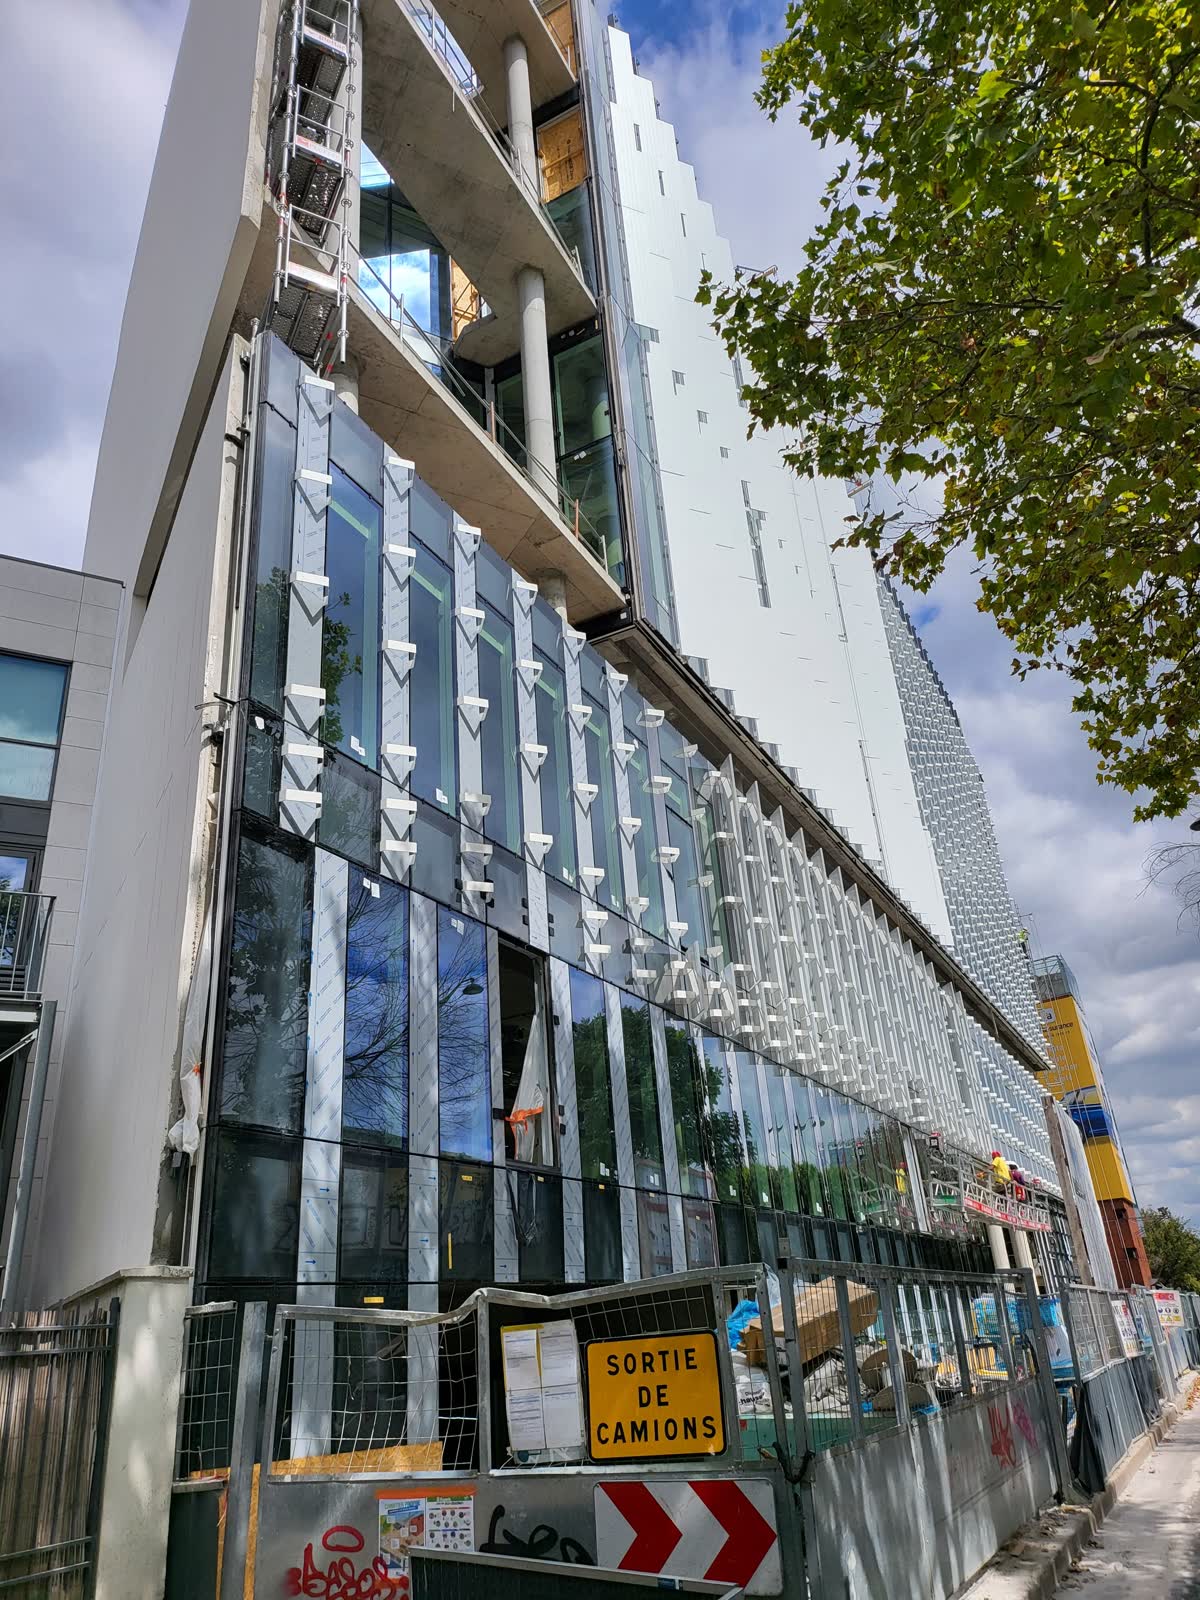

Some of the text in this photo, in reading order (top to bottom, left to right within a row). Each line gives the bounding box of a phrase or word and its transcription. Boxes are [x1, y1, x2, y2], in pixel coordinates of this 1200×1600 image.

[607, 1348, 698, 1376] SORTIE
[638, 1384, 669, 1408] DE
[597, 1415, 717, 1445] CAMIONS
